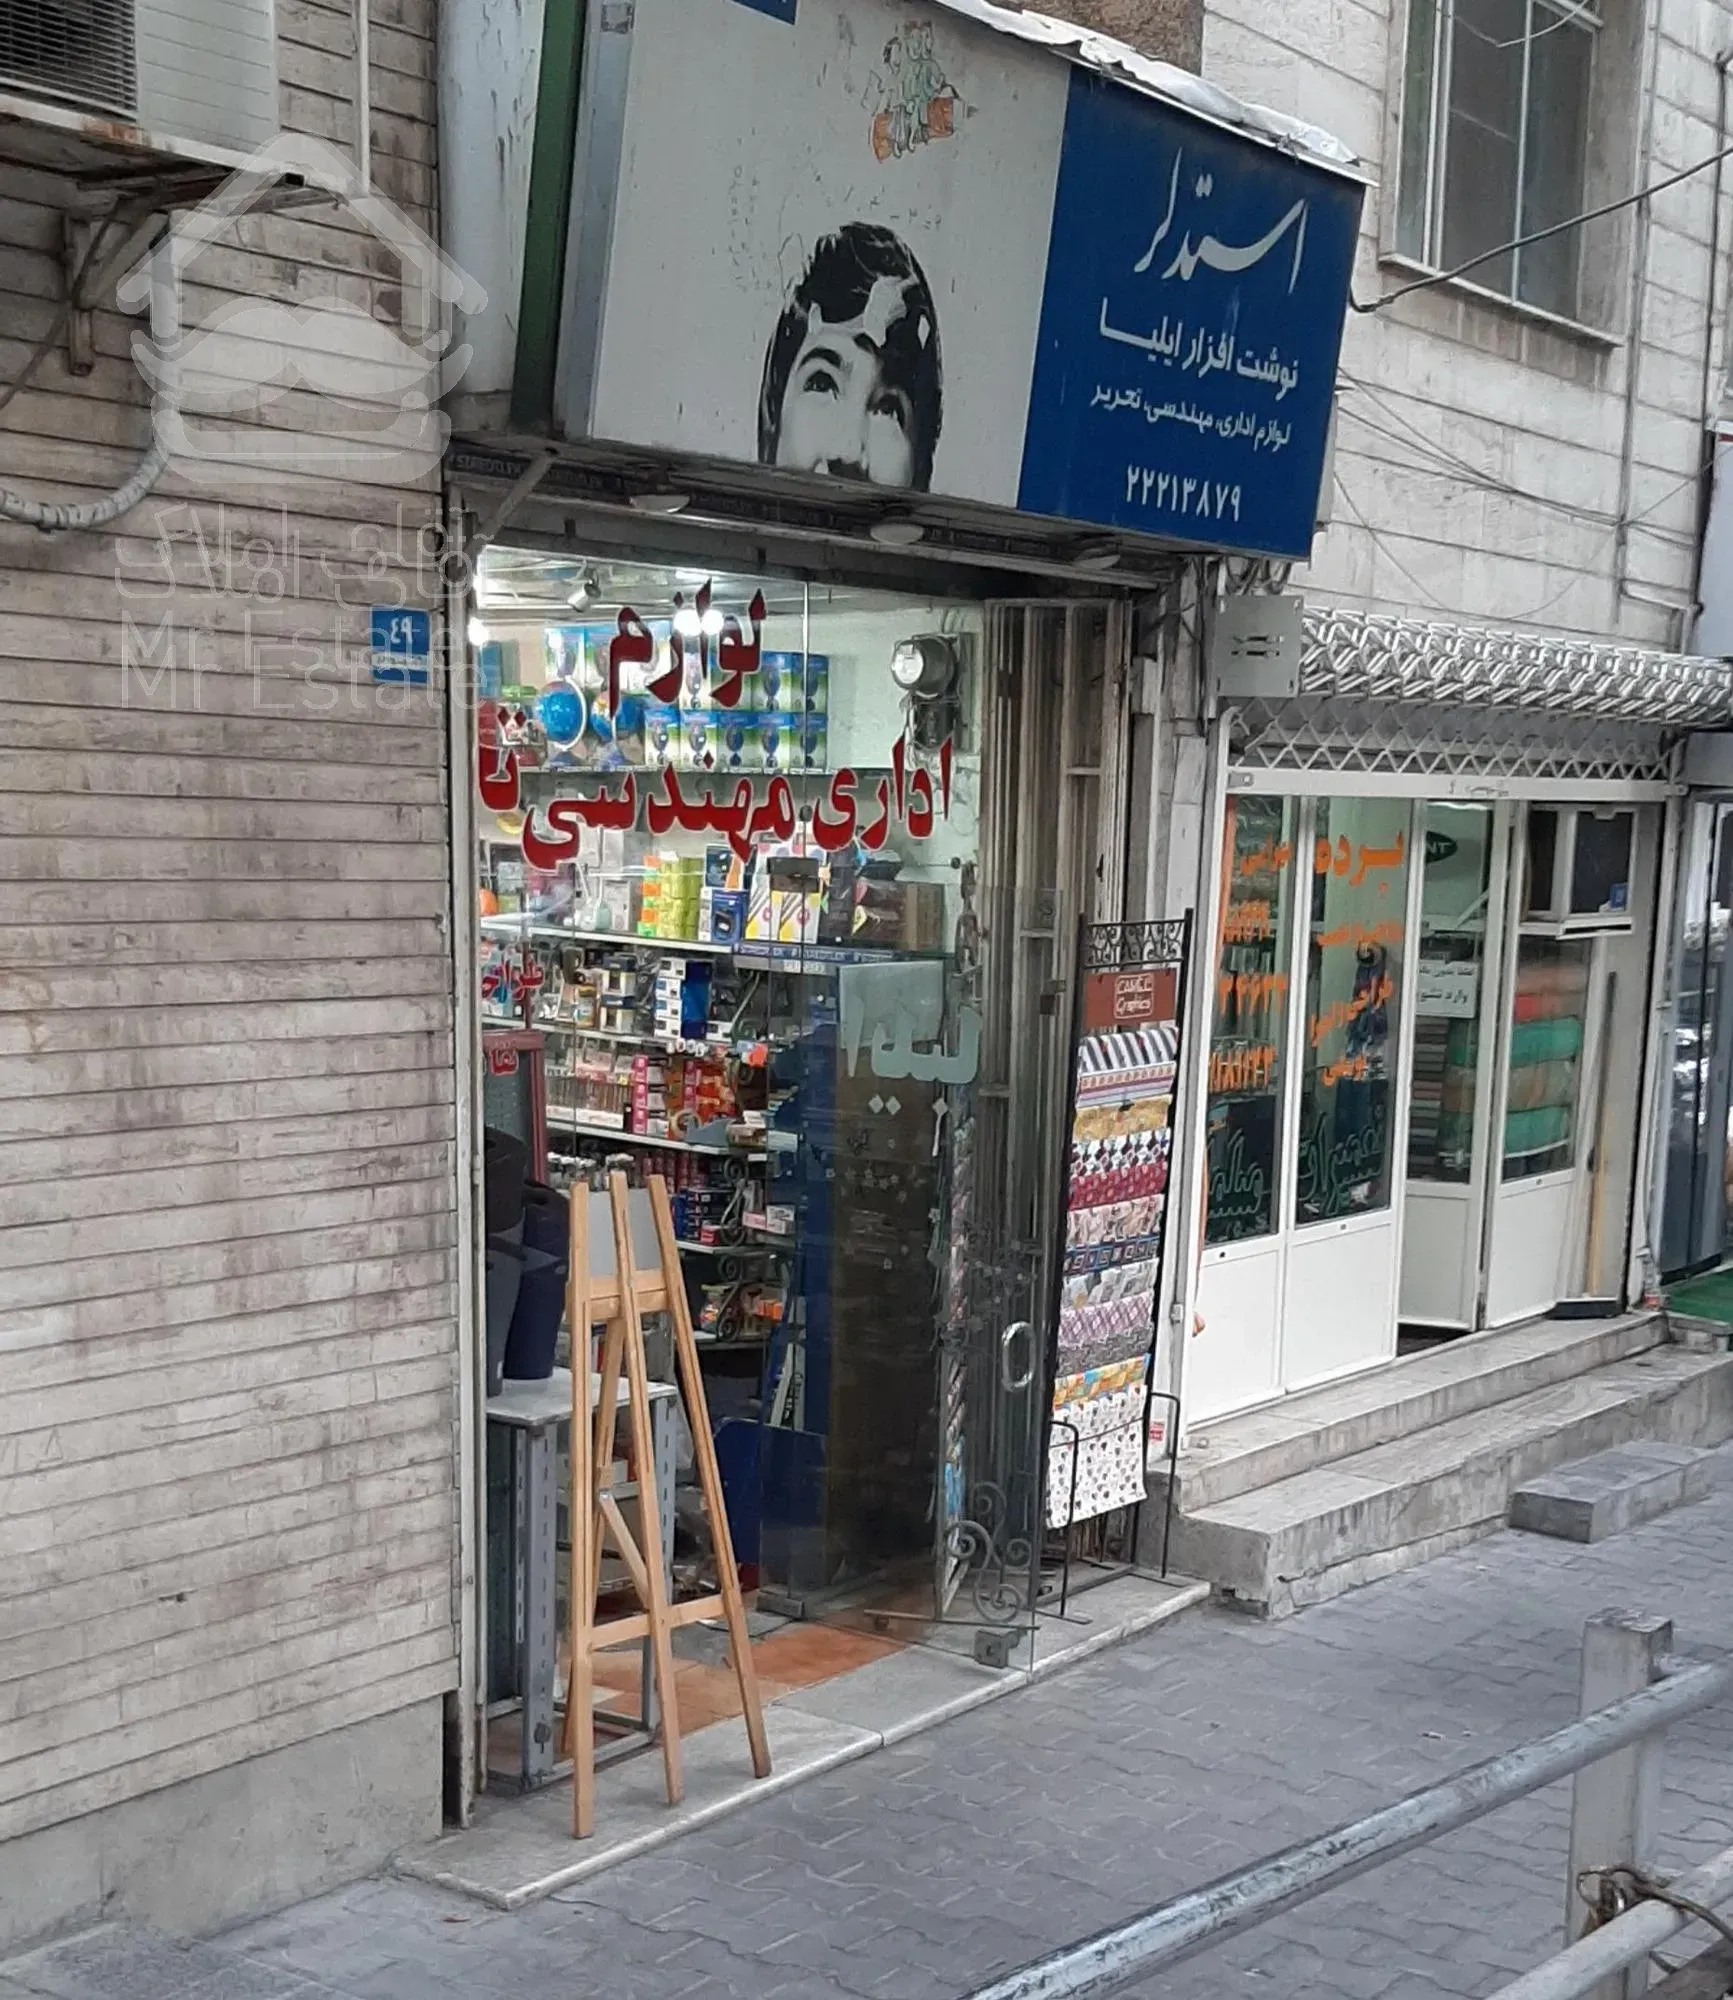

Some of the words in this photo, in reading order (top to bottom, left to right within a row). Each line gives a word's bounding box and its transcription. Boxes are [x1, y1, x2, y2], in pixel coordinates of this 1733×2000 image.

[1100, 297, 1183, 366] ایلیا
[1182, 326, 1235, 379] افزار
[1091, 383, 1142, 411] تحریر
[1236, 346, 1299, 401] نوشت
[1254, 420, 1292, 452] لوازم
[1126, 466, 1241, 522] ۲۲۲۱۳۸۷۹
[609, 578, 767, 718] لوازم
[521, 750, 796, 874] مهندسی
[811, 736, 953, 851] اداری
